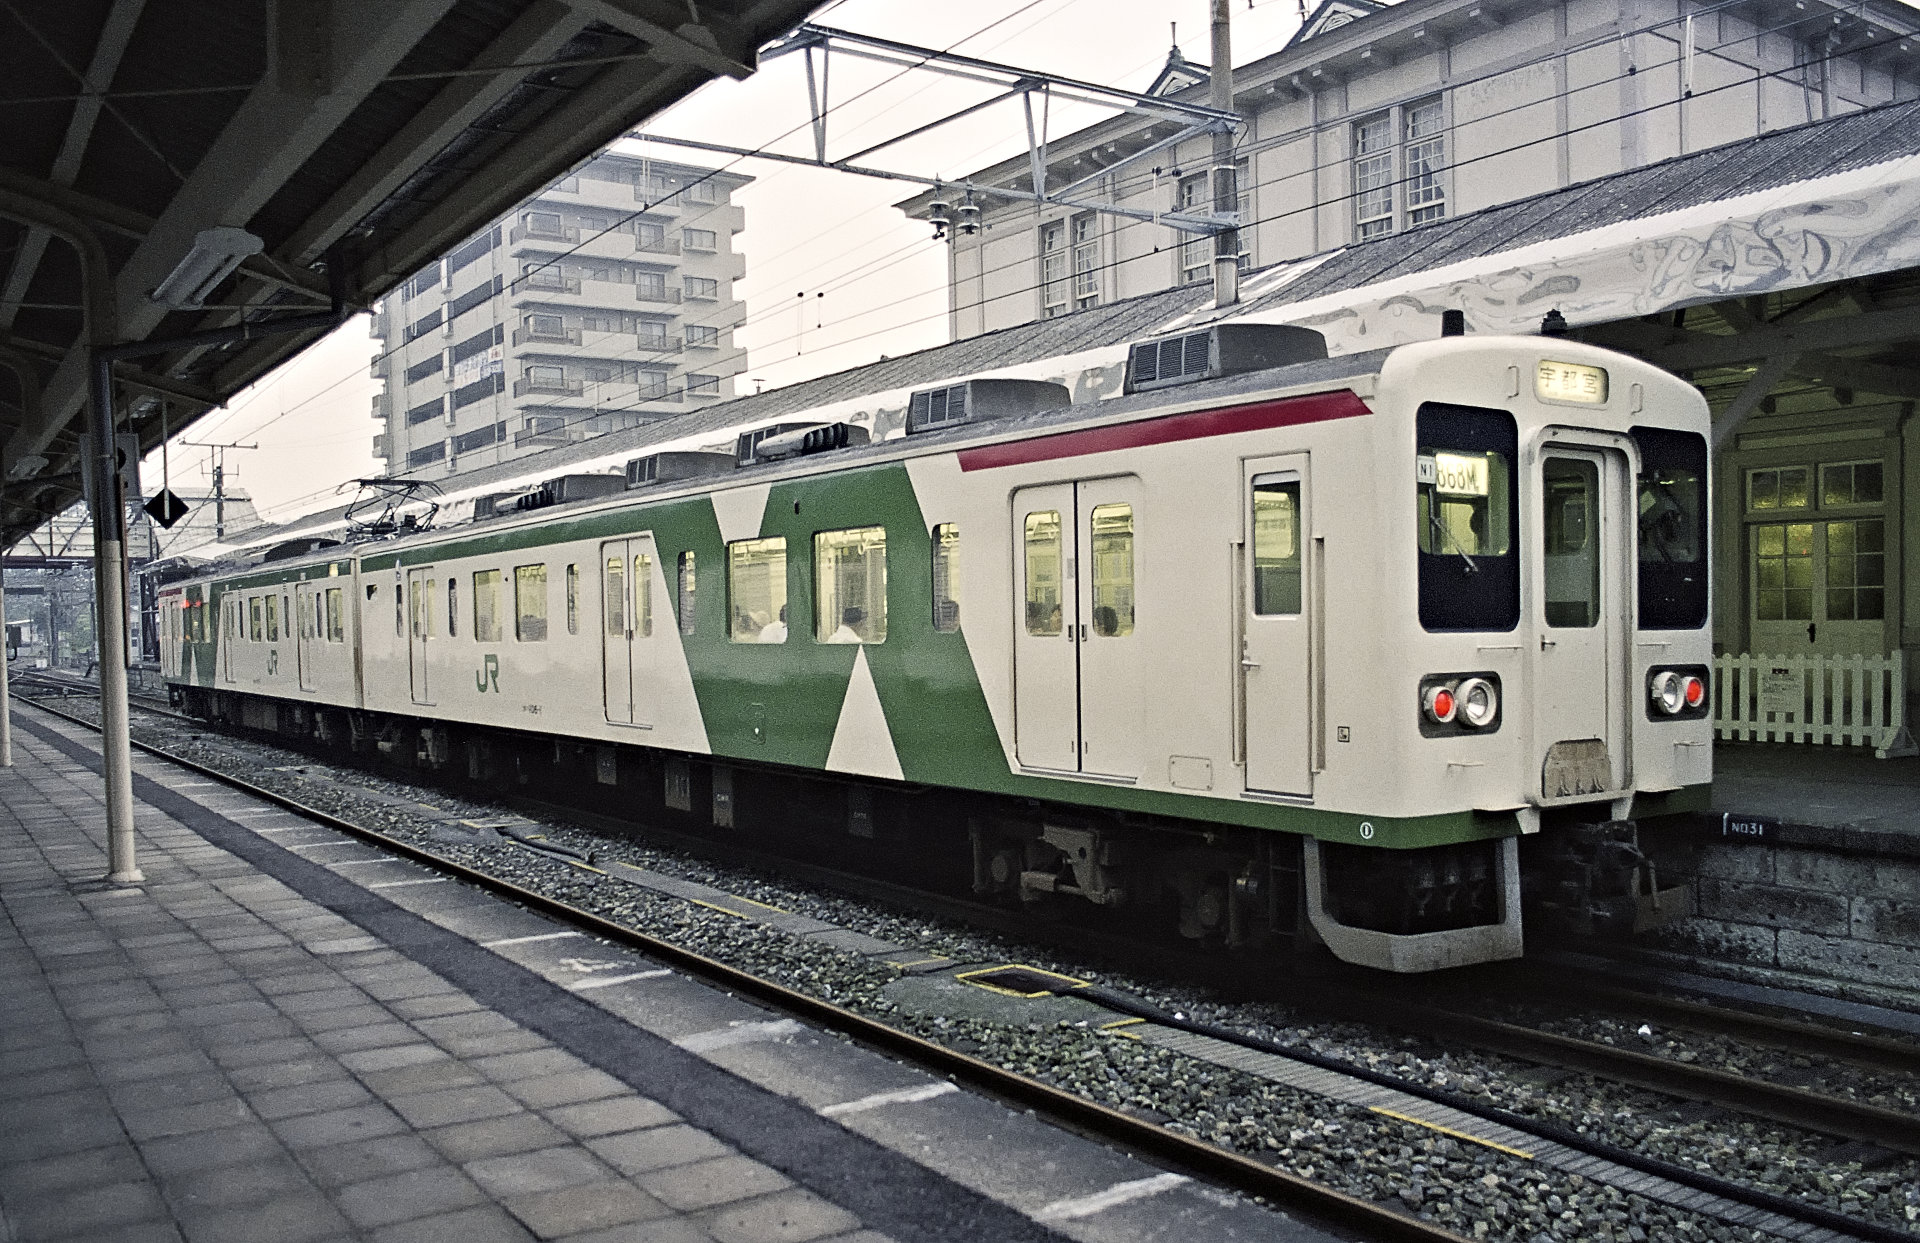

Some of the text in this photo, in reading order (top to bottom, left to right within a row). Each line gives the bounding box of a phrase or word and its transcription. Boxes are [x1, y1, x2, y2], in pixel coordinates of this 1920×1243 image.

[1540, 366, 1597, 394] 宇都宮
[266, 649, 278, 675] JR
[476, 654, 499, 693] JR
